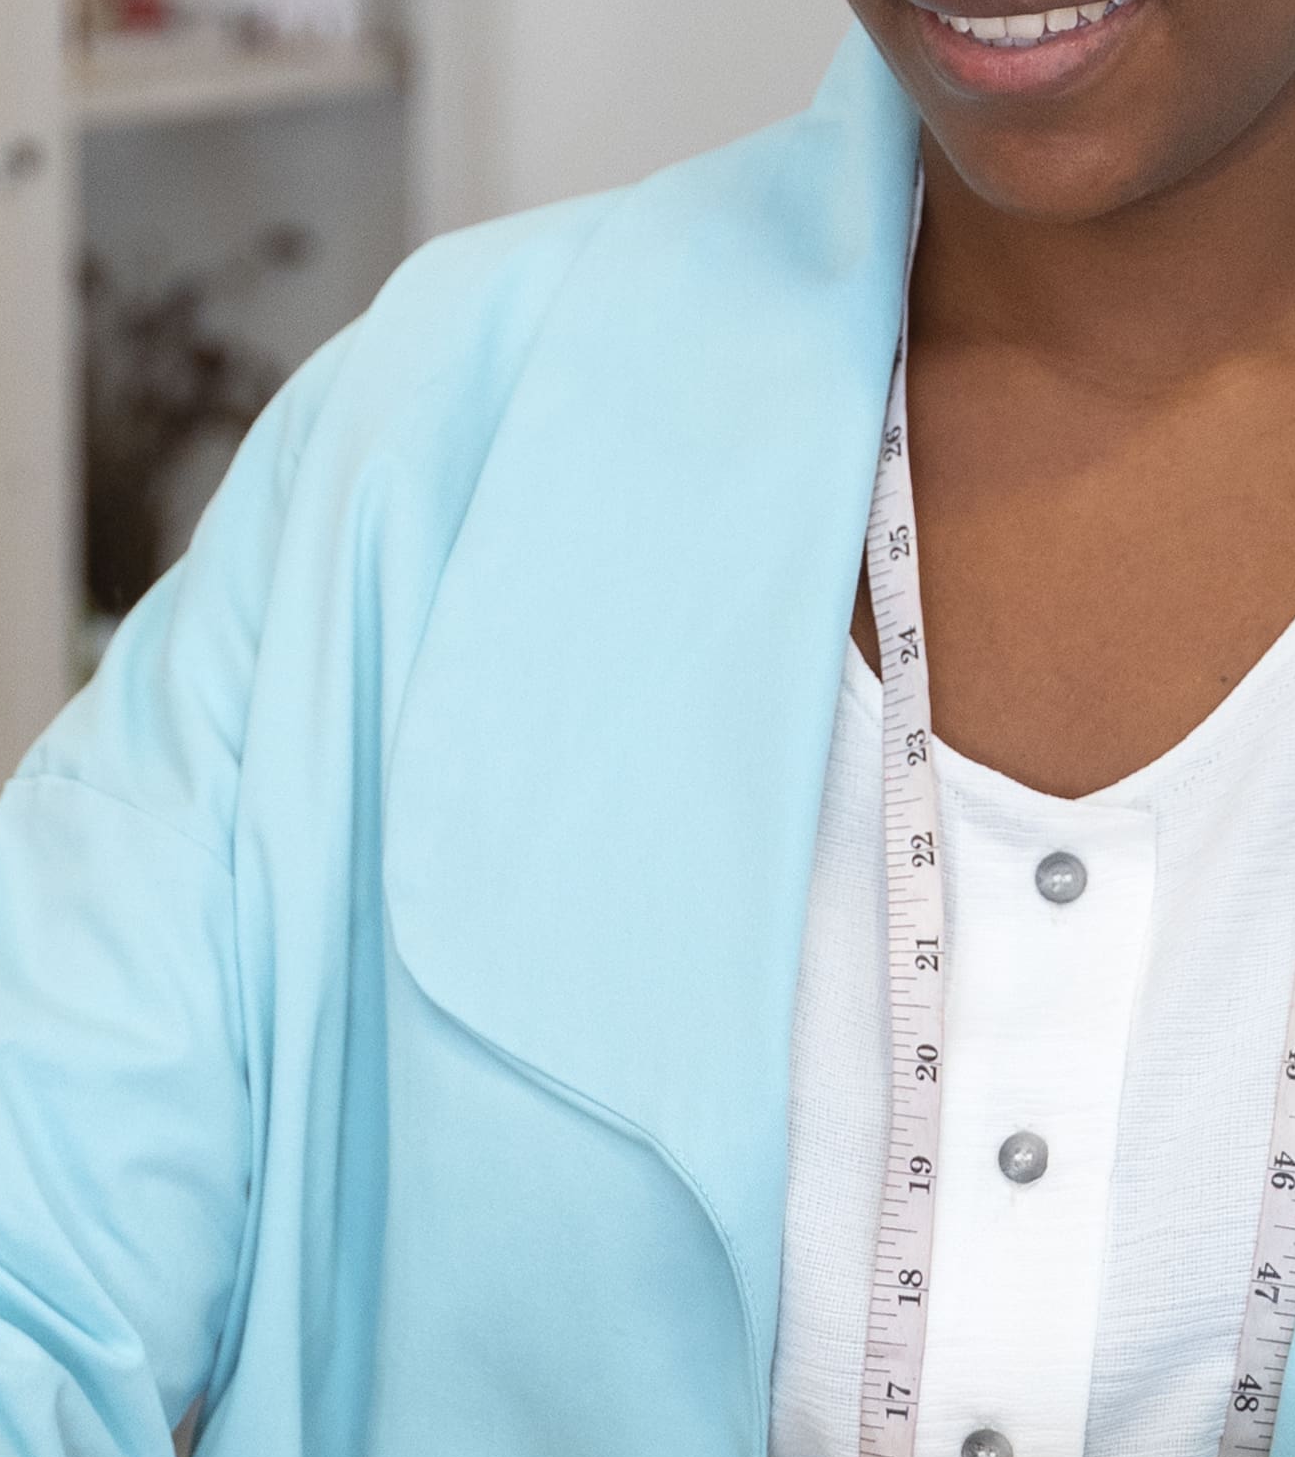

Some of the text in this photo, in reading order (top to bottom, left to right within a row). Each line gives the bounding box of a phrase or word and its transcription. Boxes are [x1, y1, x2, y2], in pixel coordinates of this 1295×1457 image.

[882, 425, 901, 461] 26
[890, 525, 910, 561] 25
[899, 625, 920, 663] 24
[906, 728, 927, 766] 23
[911, 831, 935, 868] 22
[915, 937, 938, 972] 21
[915, 1044, 938, 1083] 20
[910, 1155, 932, 1194] 19
[899, 1269, 923, 1306] 18
[1255, 1263, 1281, 1303] 47
[886, 1381, 910, 1420] 17
[1233, 1374, 1262, 1412] 48
